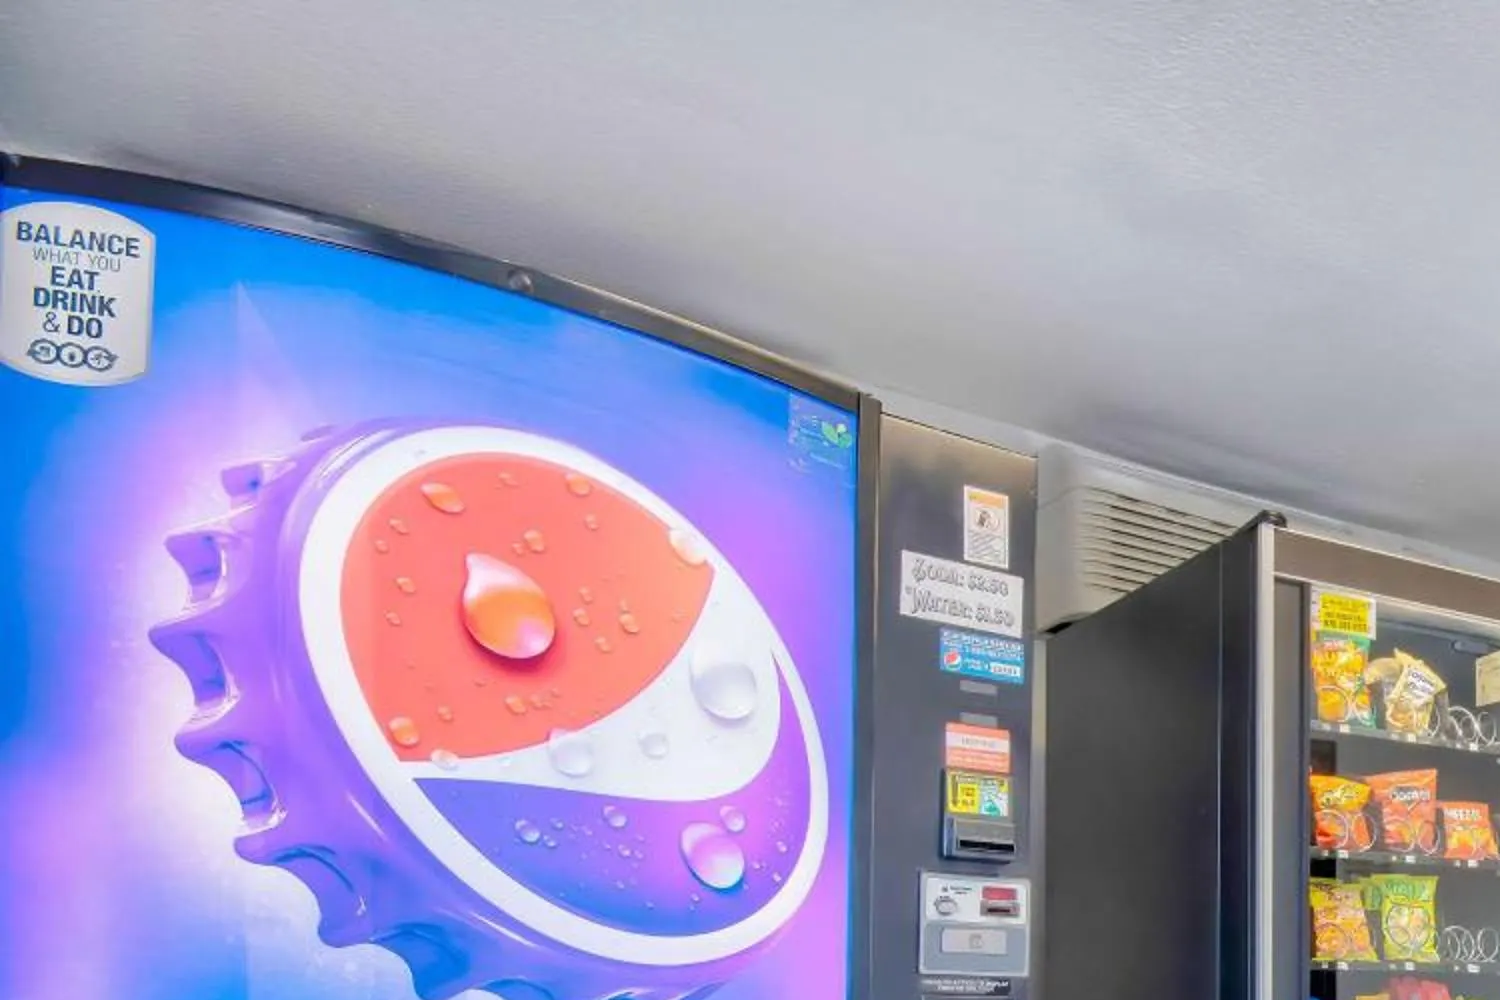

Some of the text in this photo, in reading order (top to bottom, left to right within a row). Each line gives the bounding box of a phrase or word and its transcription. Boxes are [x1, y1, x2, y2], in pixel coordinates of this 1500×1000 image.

[17, 220, 141, 258] BALANCE
[33, 247, 121, 272] WHAT YOU
[33, 287, 117, 318] DRINK
[42, 311, 103, 339] & DO
